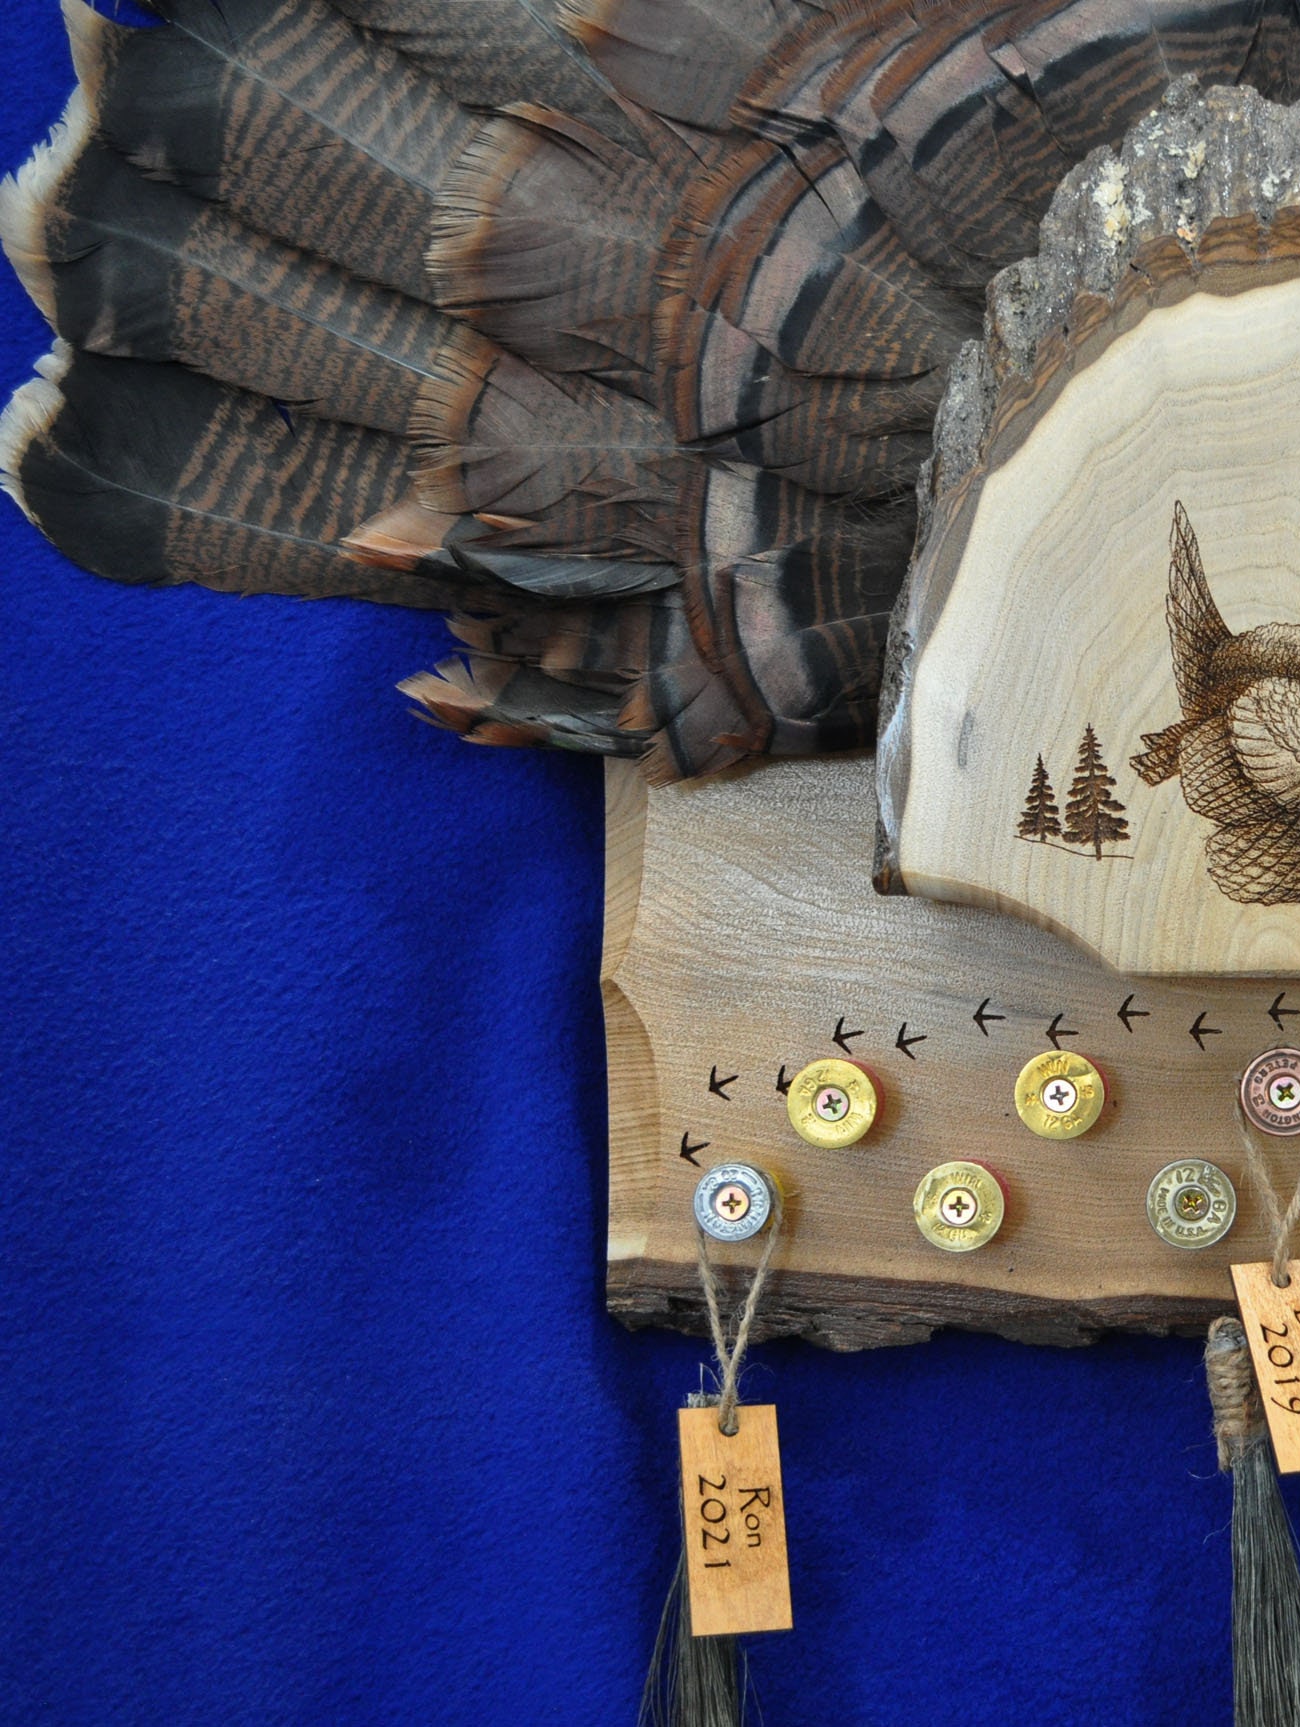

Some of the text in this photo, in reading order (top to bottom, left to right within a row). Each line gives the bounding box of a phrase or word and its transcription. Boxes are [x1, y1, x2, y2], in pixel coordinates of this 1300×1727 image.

[1037, 1059, 1069, 1078] WIN
[1254, 1058, 1298, 1085] PETERS
[1043, 1114, 1057, 1129] 12
[1175, 1167, 1195, 1184] 12
[1156, 1187, 1170, 1216] MADE
[698, 1474, 732, 1569] 2021
[738, 1486, 772, 1549] Ron
